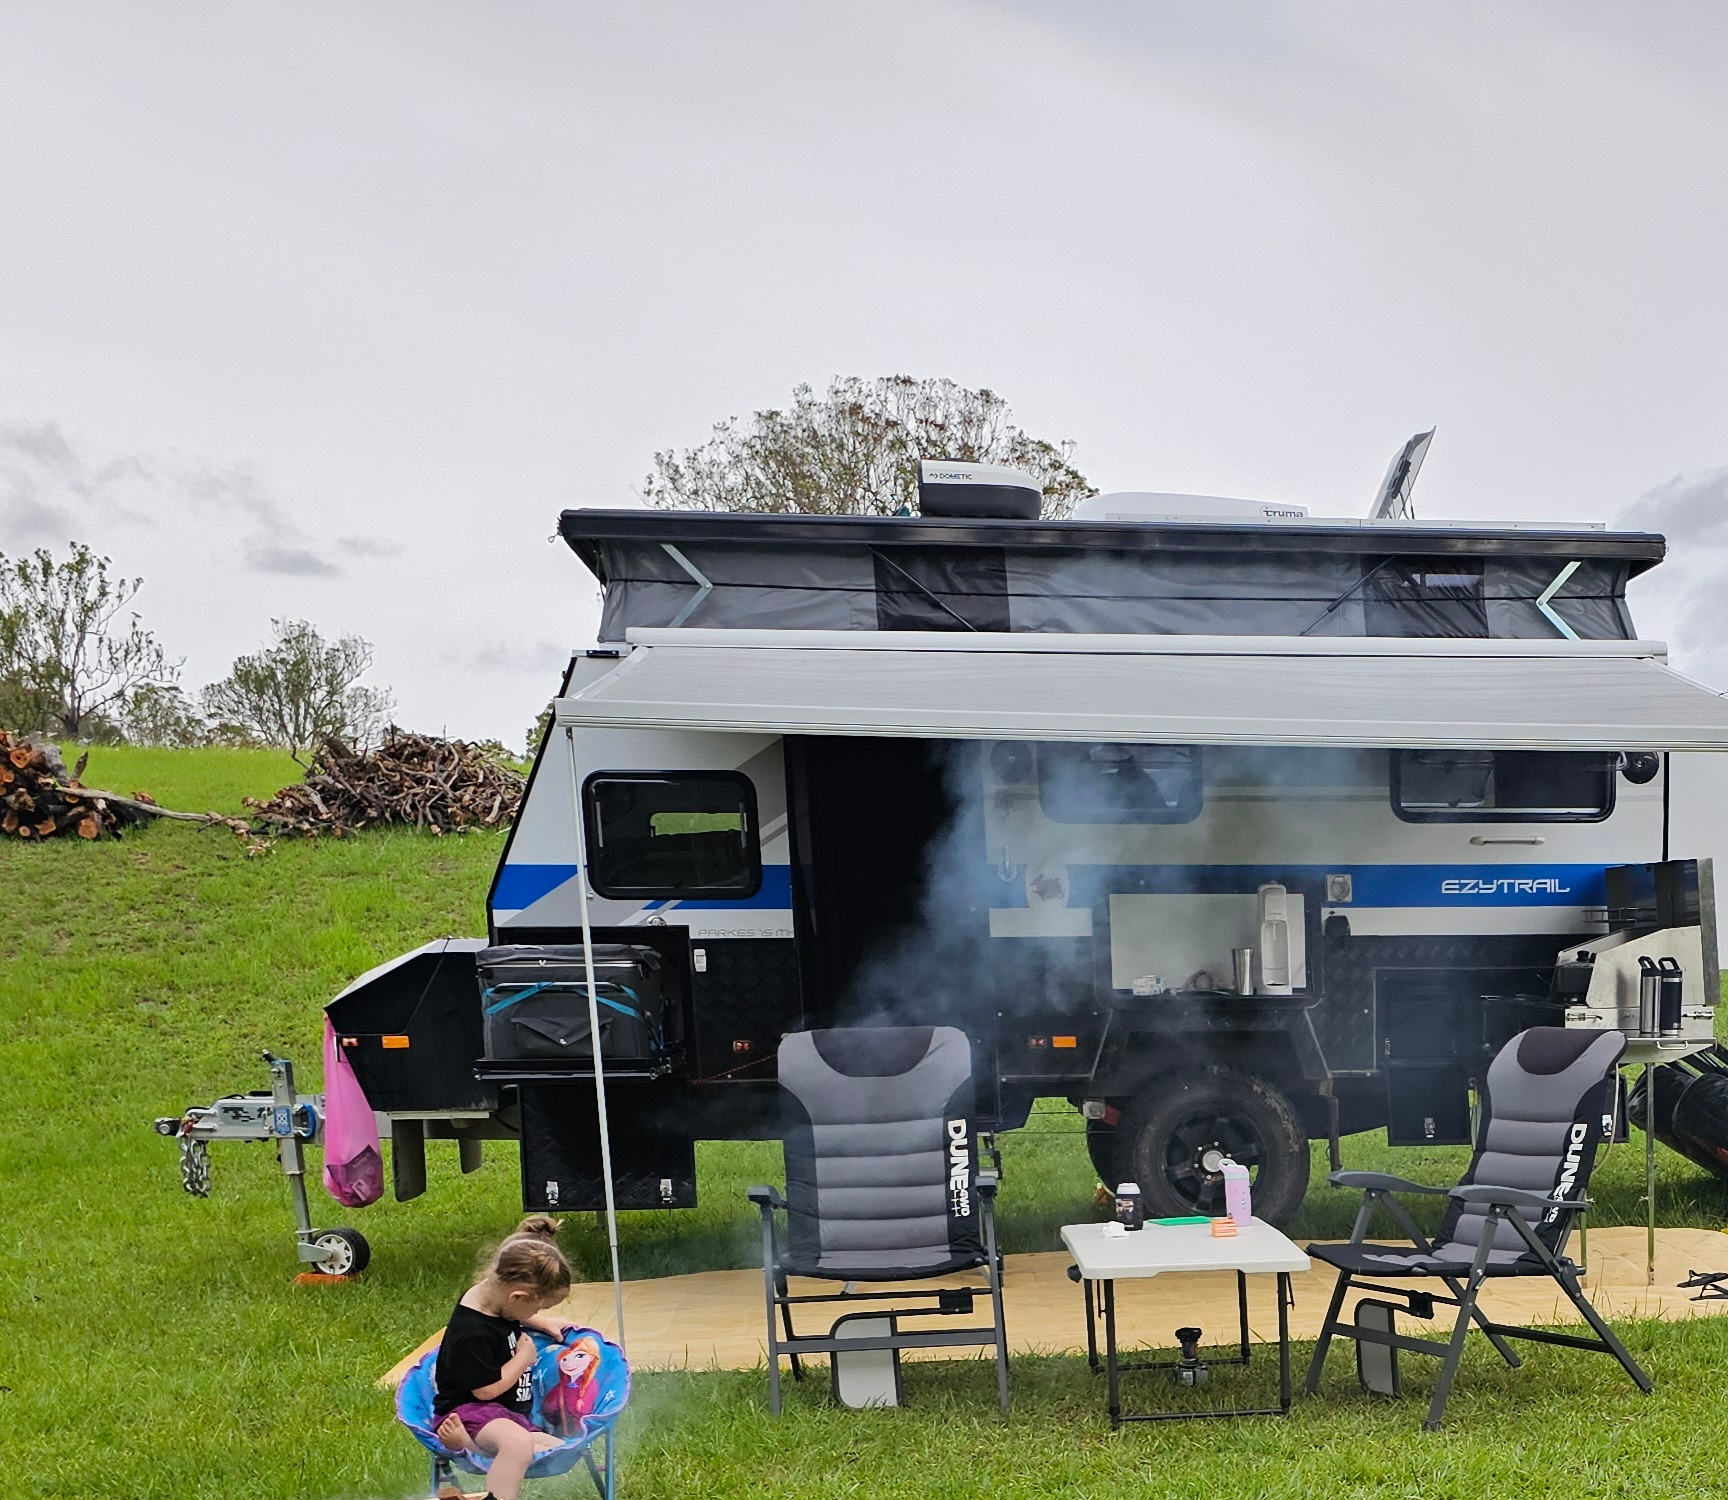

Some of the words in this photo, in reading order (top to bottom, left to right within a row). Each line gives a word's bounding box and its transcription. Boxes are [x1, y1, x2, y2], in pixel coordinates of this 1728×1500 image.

[1263, 509, 1303, 518] truma
[1441, 878, 1571, 894] EZYTRAIL
[698, 928, 756, 937] PARKES
[947, 1119, 970, 1191] DUNE
[1553, 1123, 1588, 1197] DUNE
